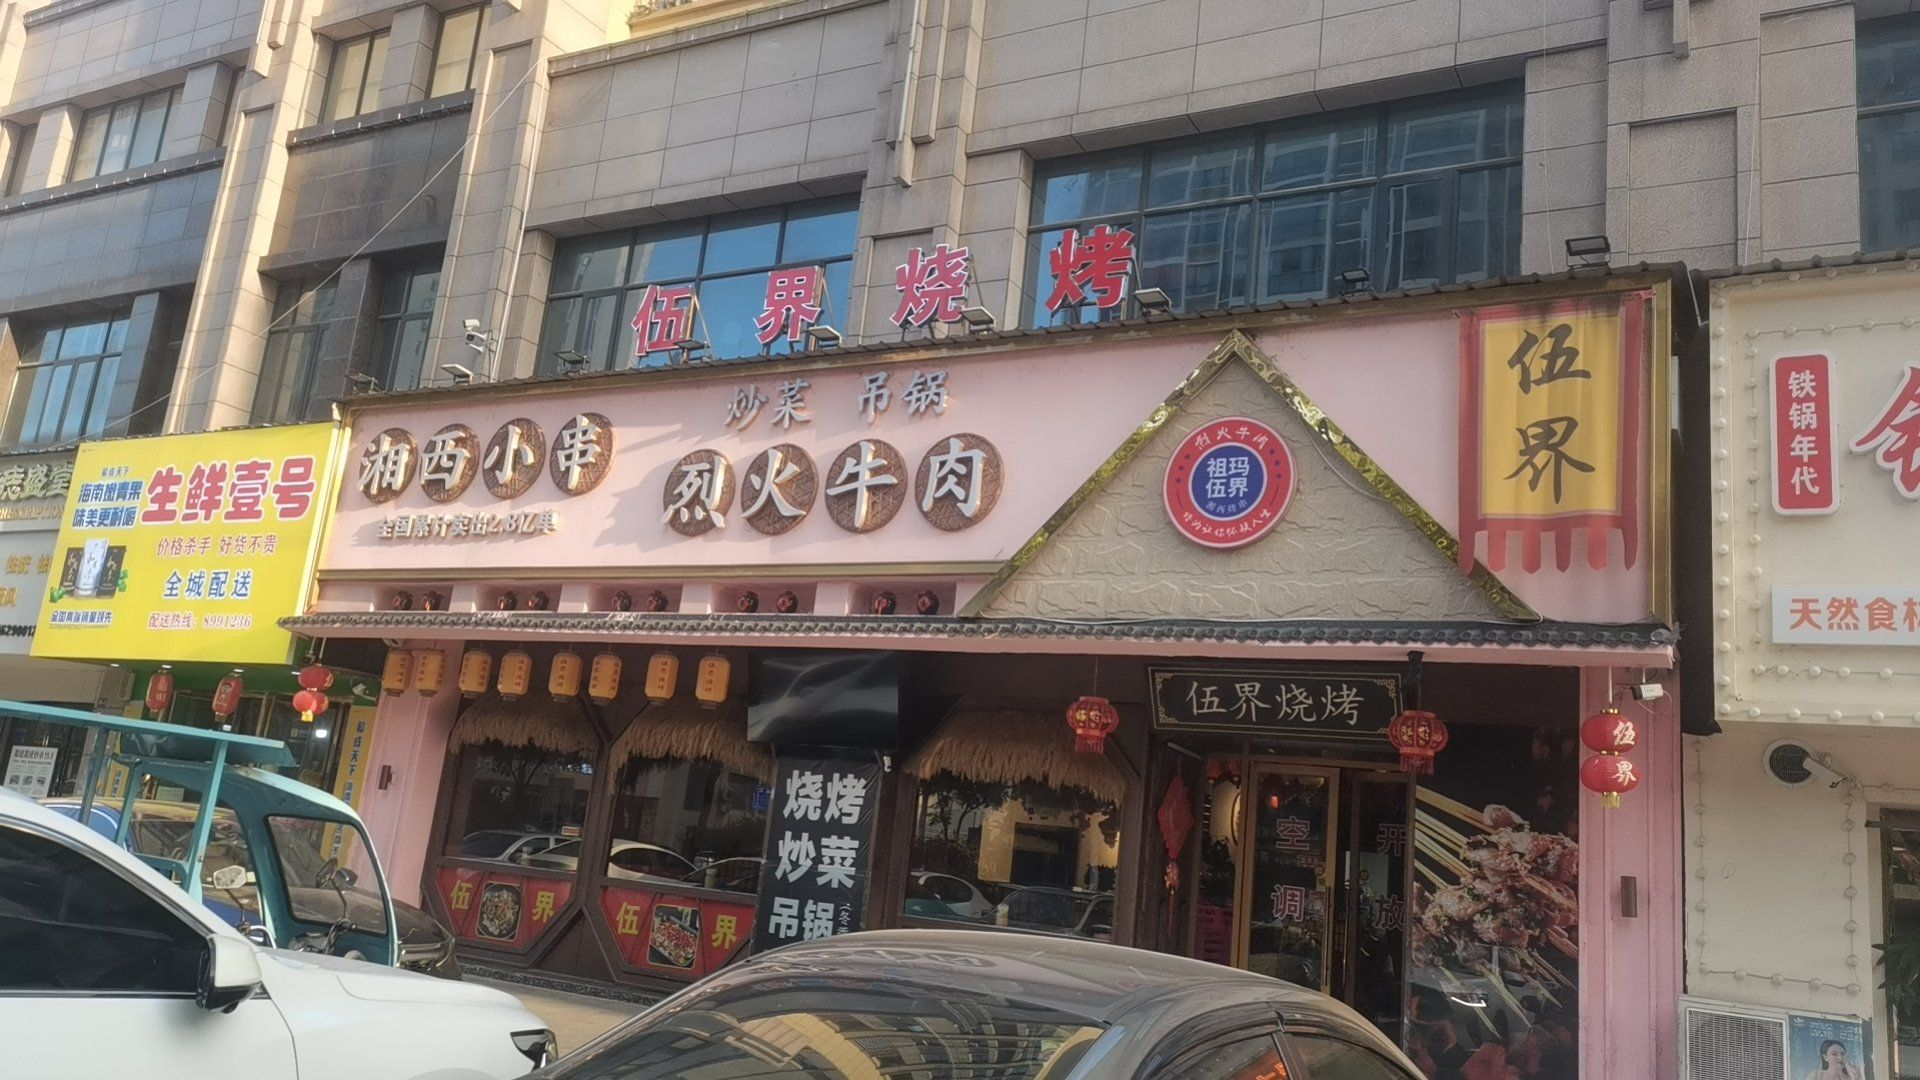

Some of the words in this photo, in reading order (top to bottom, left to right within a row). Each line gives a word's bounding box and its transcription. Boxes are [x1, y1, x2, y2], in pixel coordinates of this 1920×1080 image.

[630, 224, 1134, 357] 伍界烧烤
[723, 379, 813, 431] 炒菜
[857, 370, 949, 425] 吊锅
[1503, 322, 1596, 505] 伍界
[357, 414, 603, 495] 湘西小串
[1195, 425, 1268, 450] 烈火牛肉
[1787, 370, 1820, 496] 铁锅年代
[141, 456, 316, 523] 生鲜壹号
[661, 436, 988, 530] 烈火牛肉
[1205, 477, 1249, 499] 伍界
[1206, 456, 1250, 478] 祖玛
[157, 536, 212, 557] 价格杀手
[217, 534, 277, 554] 好货不贵
[163, 570, 252, 598] 全城配送
[1185, 681, 1365, 726] 伍界烧烤
[782, 769, 868, 825] 烧烤
[774, 831, 860, 889] 炒菜
[450, 880, 473, 911] 伍
[532, 890, 555, 923] 界
[616, 902, 642, 936] 伍
[711, 914, 738, 949] 界
[767, 896, 836, 942] 吊锅
